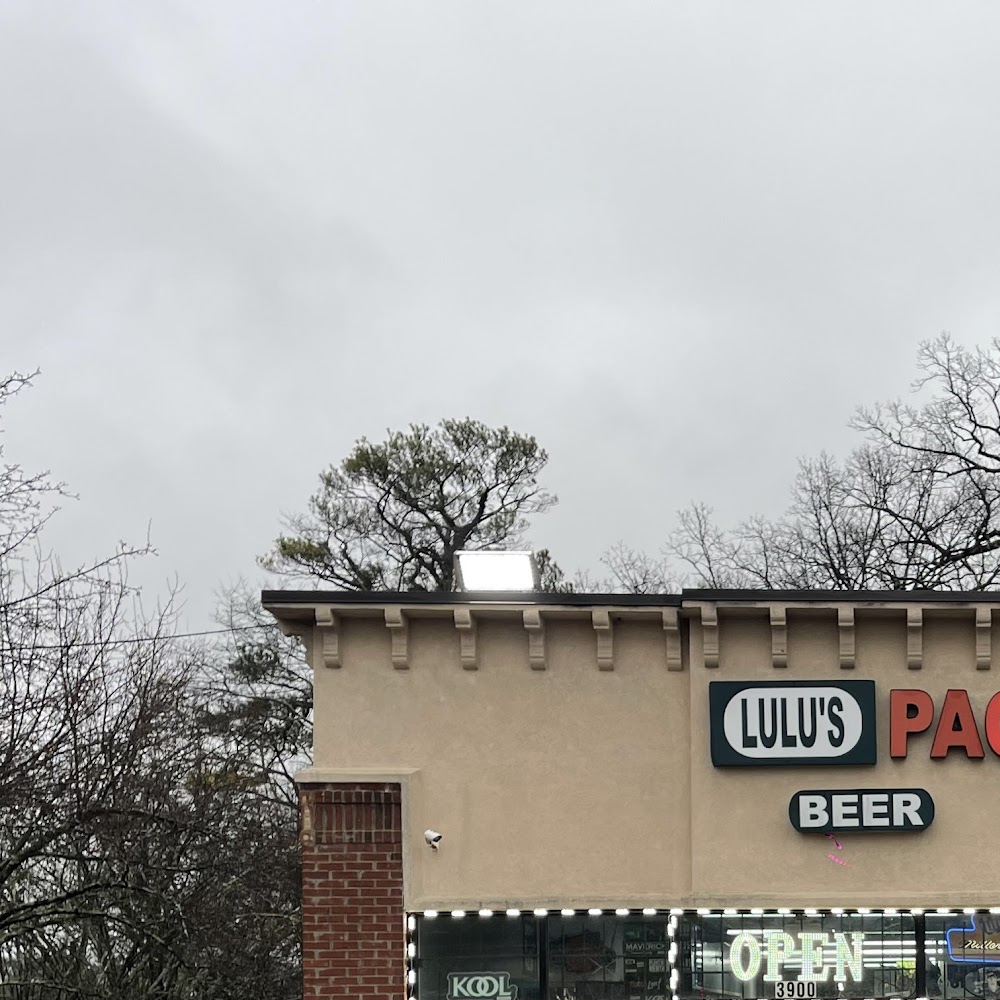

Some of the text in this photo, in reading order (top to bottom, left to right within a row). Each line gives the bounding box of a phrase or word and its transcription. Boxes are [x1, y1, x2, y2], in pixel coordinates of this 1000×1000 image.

[741, 697, 845, 748] LULU'S
[799, 793, 924, 828] BEER
[730, 932, 865, 981] OPEN
[453, 976, 512, 998] KOOL
[776, 982, 815, 998] 3900
